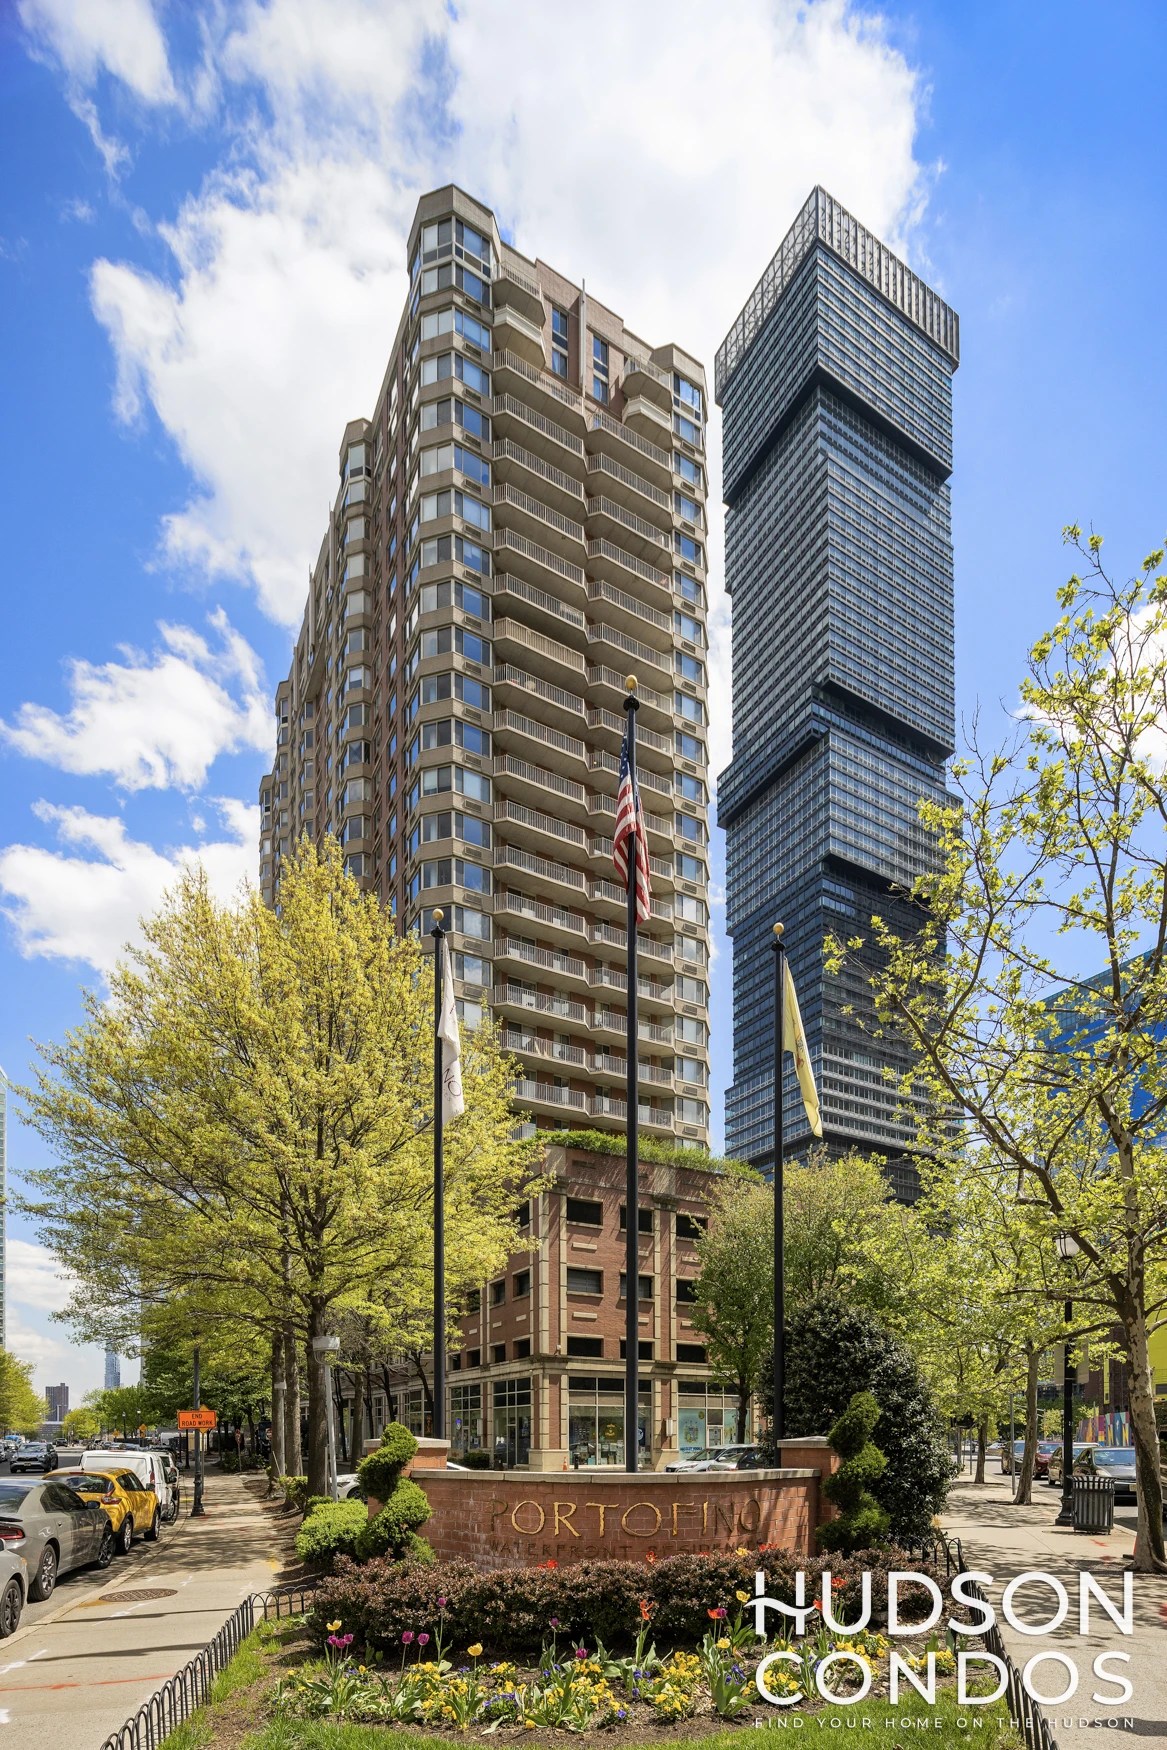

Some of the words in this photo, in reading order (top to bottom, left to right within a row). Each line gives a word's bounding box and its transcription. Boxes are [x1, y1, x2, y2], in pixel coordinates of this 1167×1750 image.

[490, 1499, 761, 1538] PORTOFINO
[490, 1541, 632, 1558] WATERFRONT
[648, 1539, 764, 1556] RESIDEN
